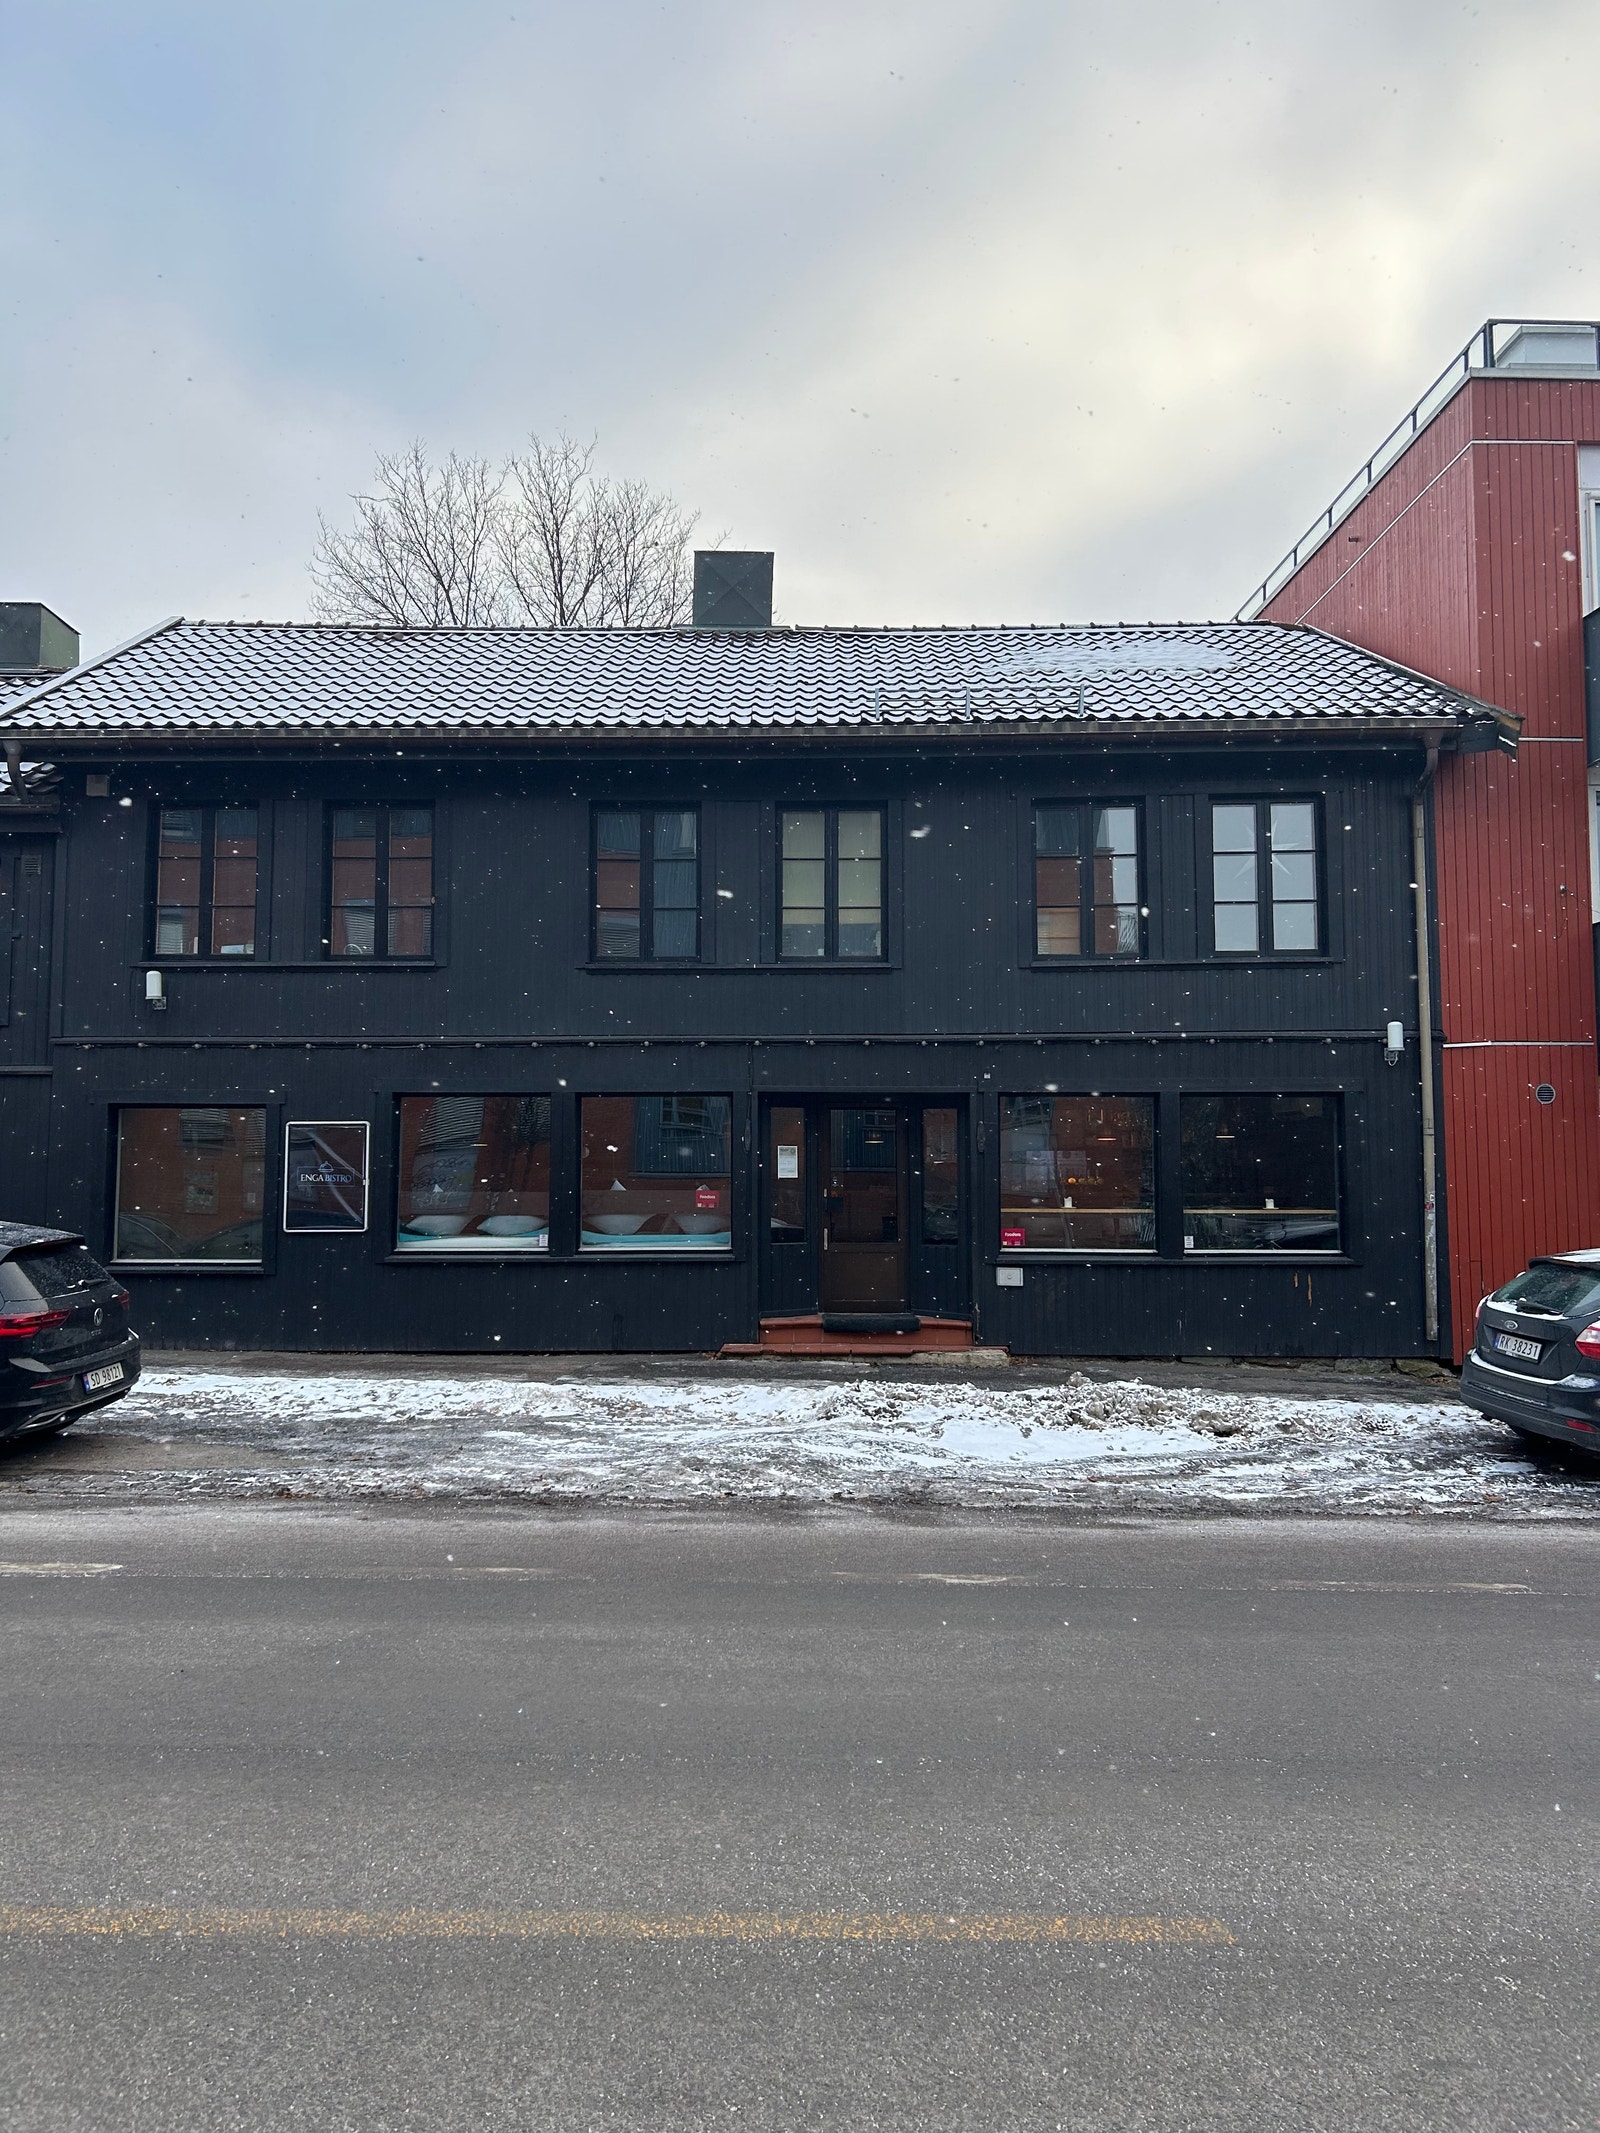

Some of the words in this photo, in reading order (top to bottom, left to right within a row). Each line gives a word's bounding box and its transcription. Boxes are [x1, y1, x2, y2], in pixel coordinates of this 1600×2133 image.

[300, 1173, 324, 1182] ENGA
[324, 1174, 352, 1183] BISTRO
[1499, 1335, 1511, 1349] RK
[1511, 1339, 1538, 1357] 38231
[90, 1372, 100, 1386] SD
[101, 1365, 121, 1383] 98121
